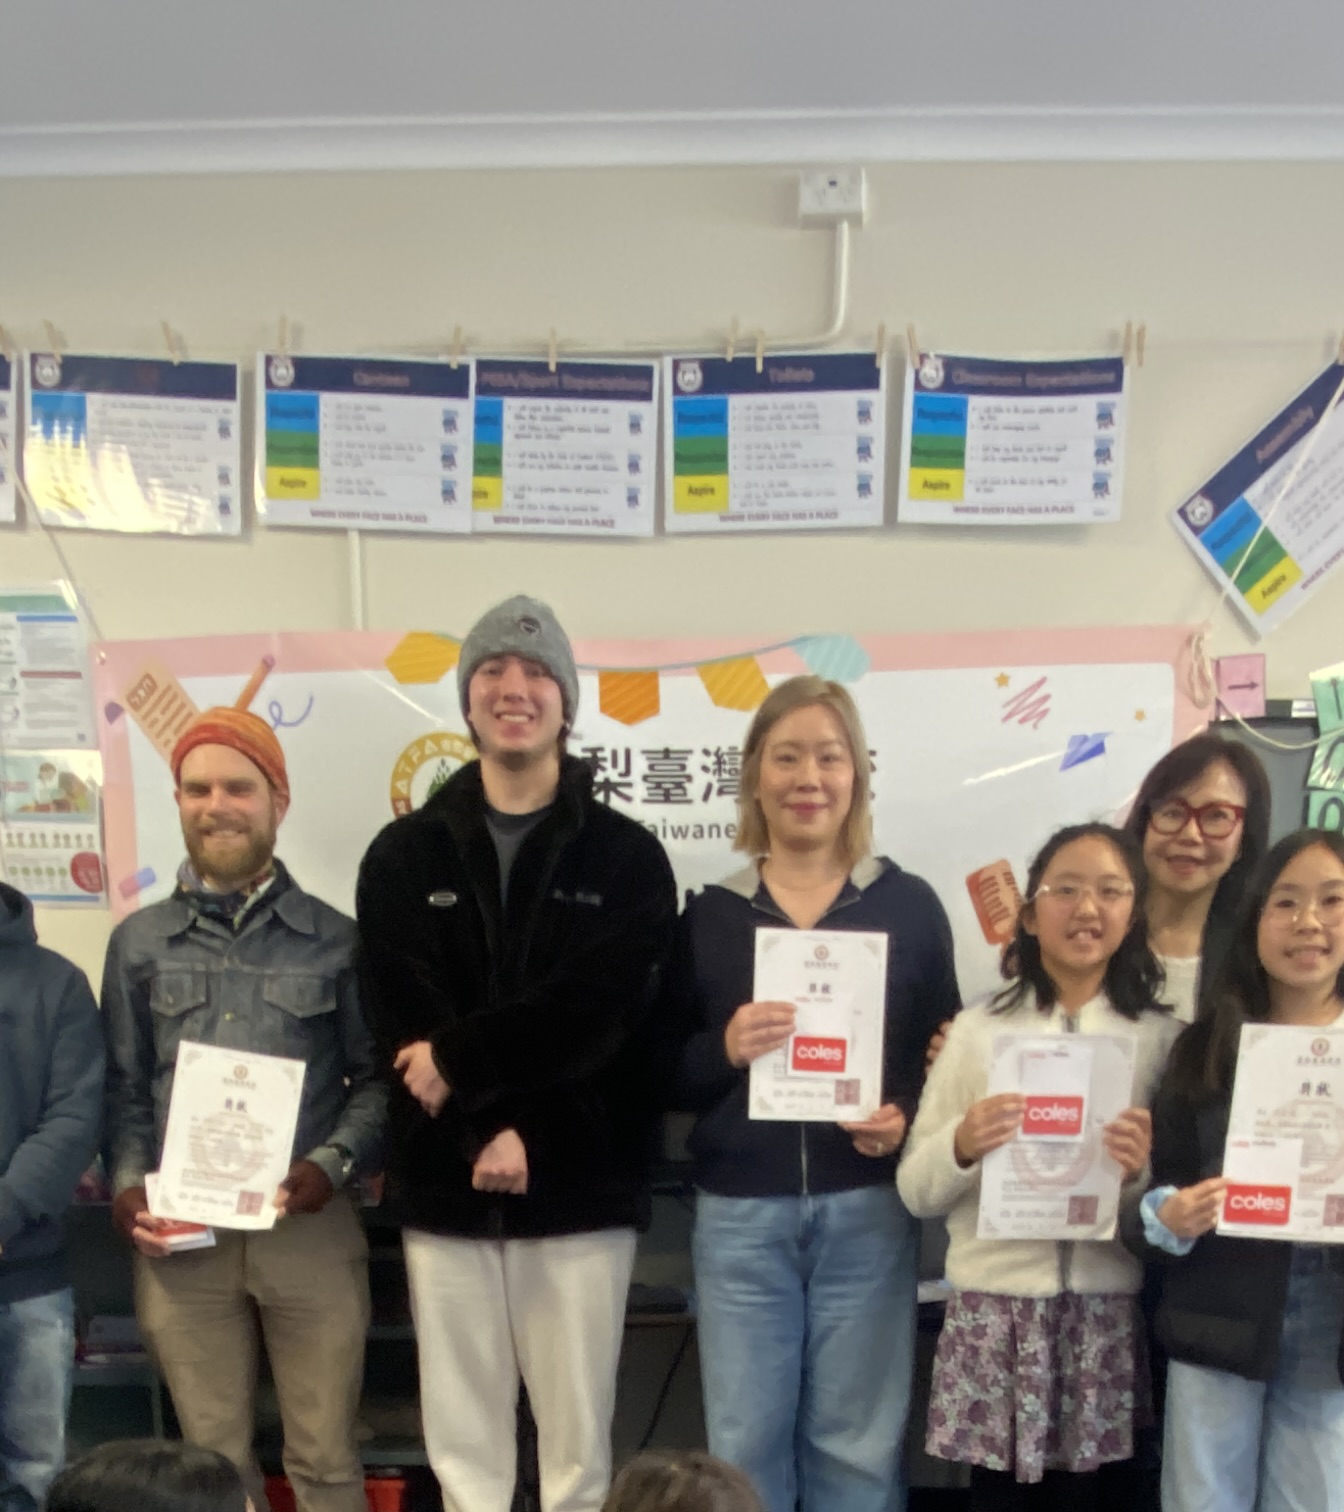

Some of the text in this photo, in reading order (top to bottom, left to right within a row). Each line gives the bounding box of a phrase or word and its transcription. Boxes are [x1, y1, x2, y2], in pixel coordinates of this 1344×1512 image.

[687, 484, 716, 497] Aspire
[922, 479, 951, 491] Aspire
[795, 1042, 843, 1062] coles
[1027, 1102, 1079, 1123] coles
[1229, 1191, 1287, 1212] coles
